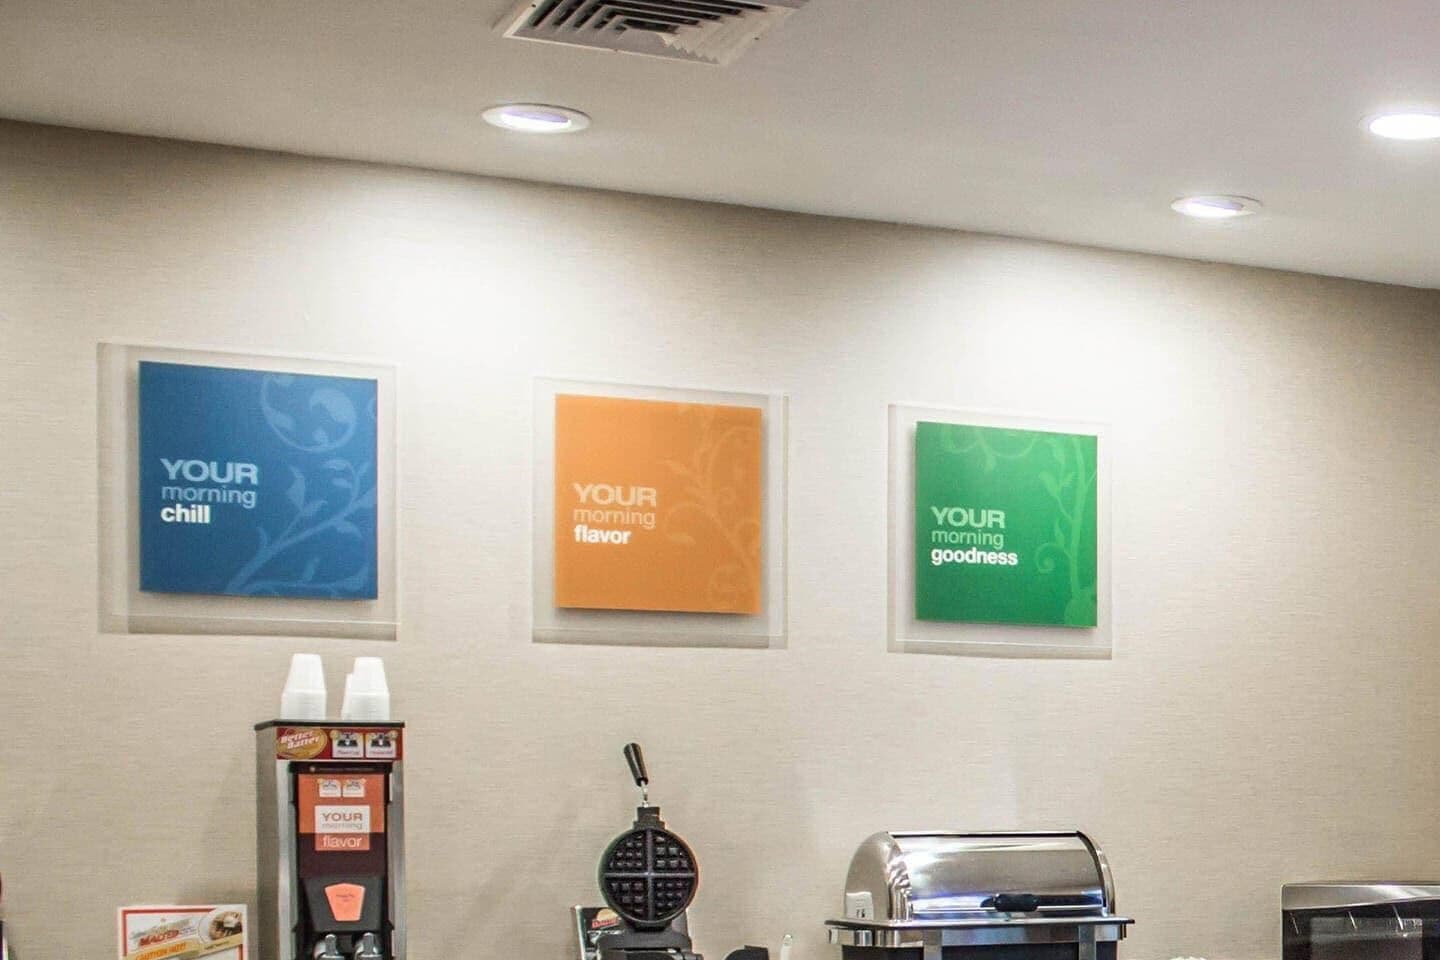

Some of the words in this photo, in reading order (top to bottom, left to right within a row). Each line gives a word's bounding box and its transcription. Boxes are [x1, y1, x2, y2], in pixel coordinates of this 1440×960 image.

[160, 458, 259, 485] YOUR
[161, 486, 256, 509] morning
[573, 482, 658, 507] YOUR
[160, 503, 211, 524] chill
[573, 508, 657, 530] morning
[930, 505, 1006, 529] YOUR
[573, 524, 632, 544] flavor
[931, 529, 1004, 550] morning
[931, 546, 1019, 566] goodness
[322, 812, 363, 822] YOUR
[323, 834, 363, 848] flavor
